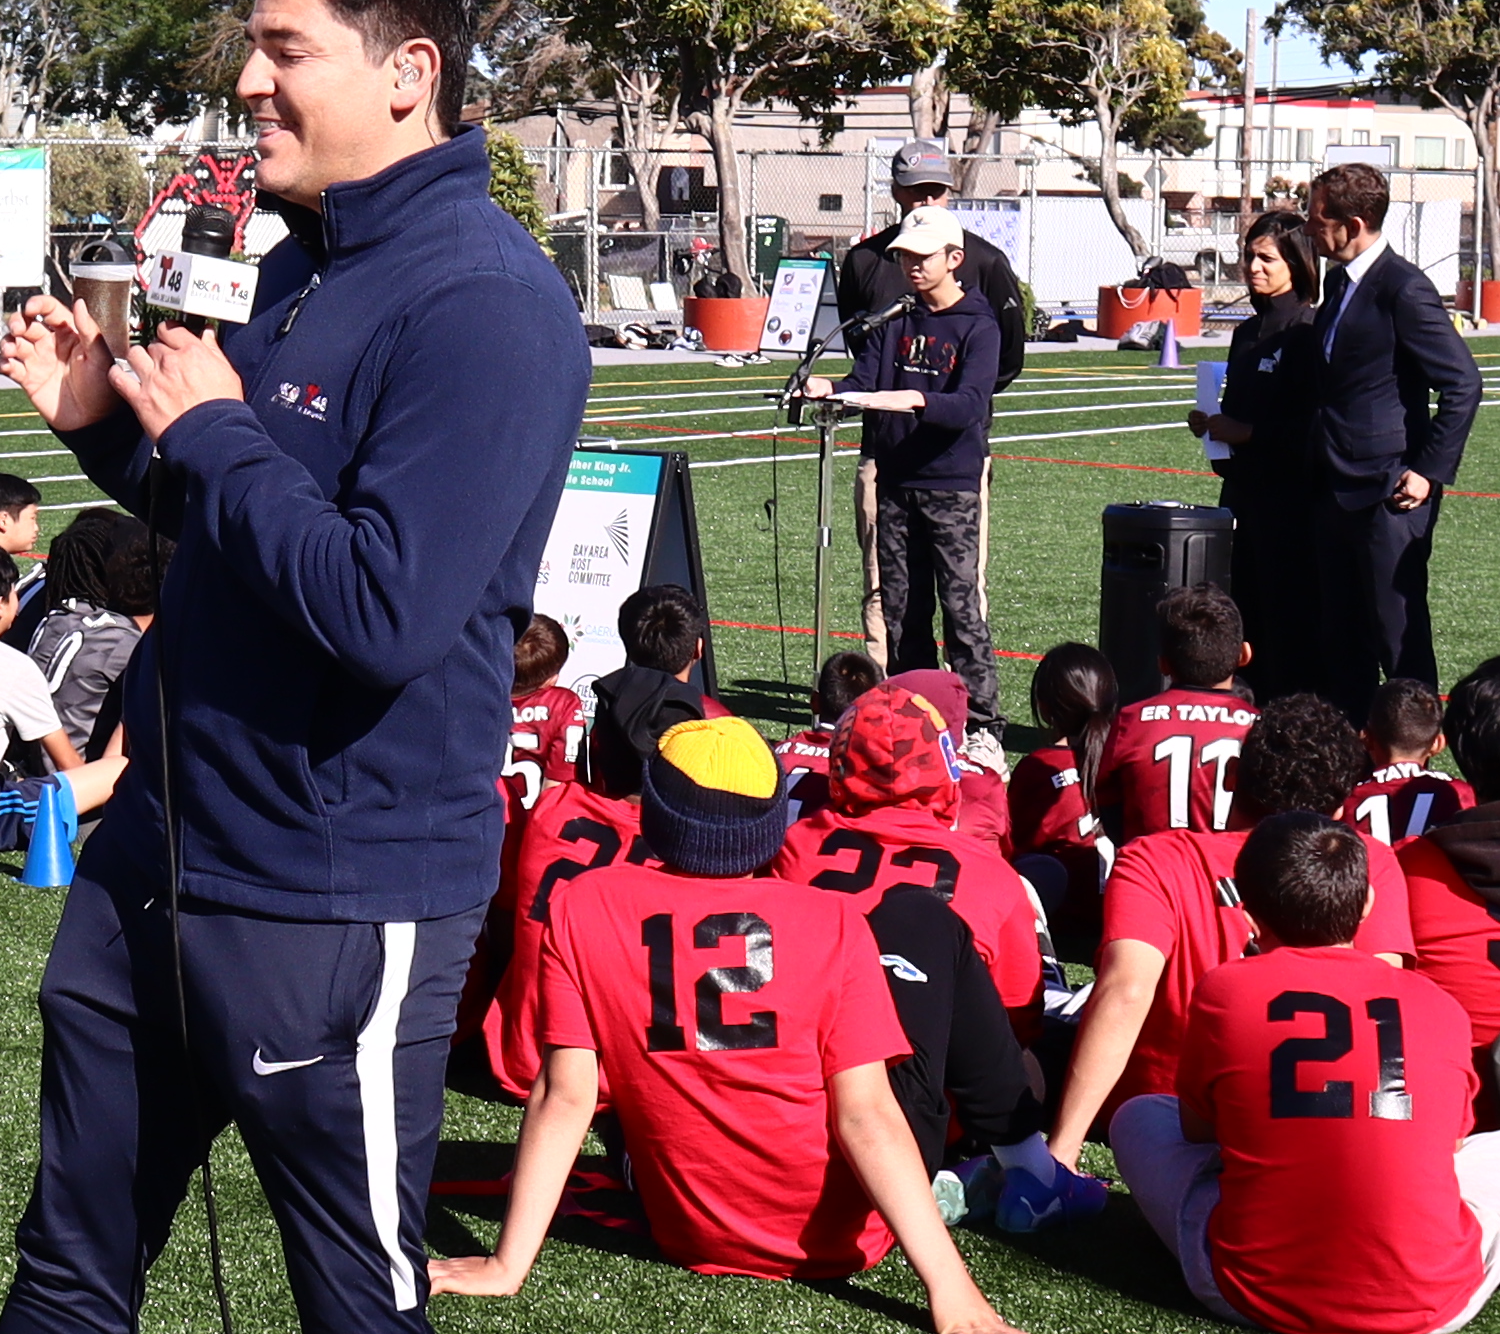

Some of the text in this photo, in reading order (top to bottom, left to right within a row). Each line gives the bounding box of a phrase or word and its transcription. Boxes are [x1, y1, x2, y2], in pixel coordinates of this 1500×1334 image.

[193, 278, 210, 292] NBC
[594, 461, 616, 474] King
[617, 463, 631, 473] Jr.
[580, 475, 613, 487] School
[573, 544, 609, 559] BAY AREA
[570, 557, 591, 570] HOST
[568, 570, 612, 586] COMMITTEE
[577, 685, 597, 699] FIEL
[513, 705, 549, 723] LOR
[1141, 704, 1254, 726] ER TAYLO
[1051, 768, 1081, 789] ER
[641, 912, 778, 1053] 12
[1268, 991, 1413, 1120] 21
